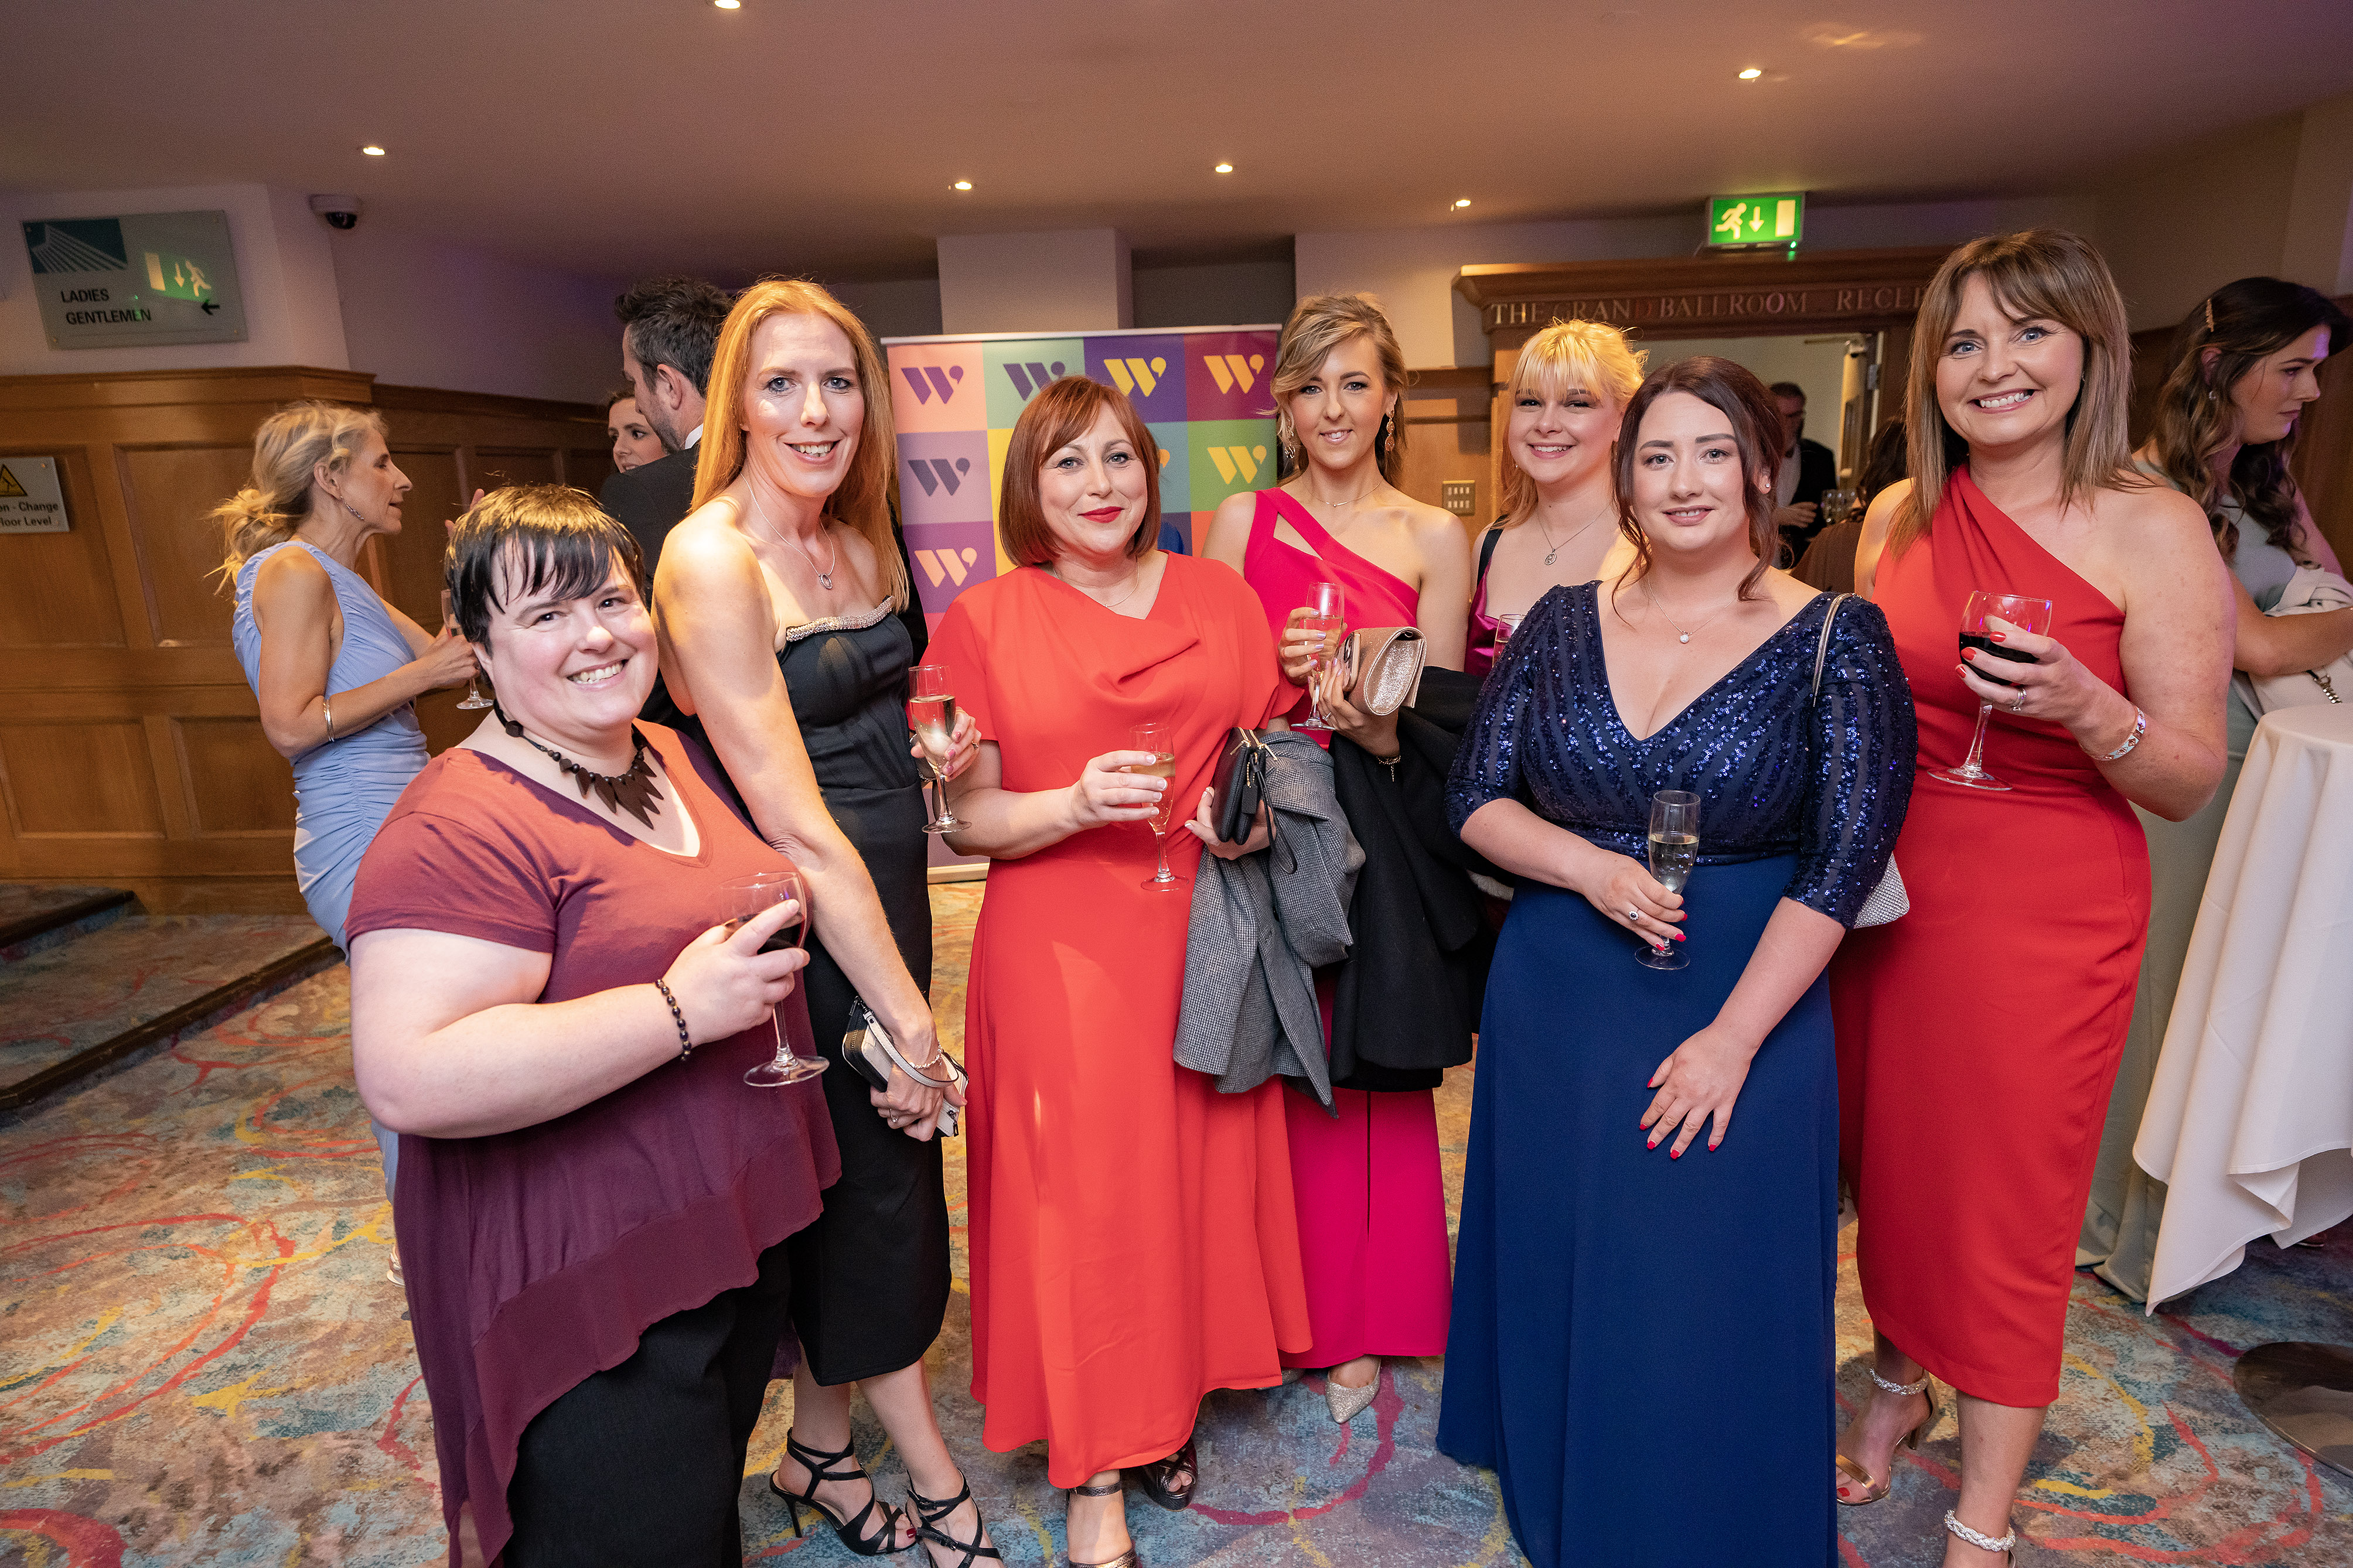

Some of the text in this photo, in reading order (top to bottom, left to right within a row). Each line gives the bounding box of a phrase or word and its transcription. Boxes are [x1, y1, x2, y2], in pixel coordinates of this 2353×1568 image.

[60, 288, 110, 303] LADIES
[1491, 302, 1544, 324] THE
[1553, 298, 1652, 322] GRAND
[1659, 293, 1807, 318] BALLROOM
[66, 308, 151, 325] GENTLEMEN
[19, 502, 58, 513] Change
[0, 515, 52, 527] loor Level
